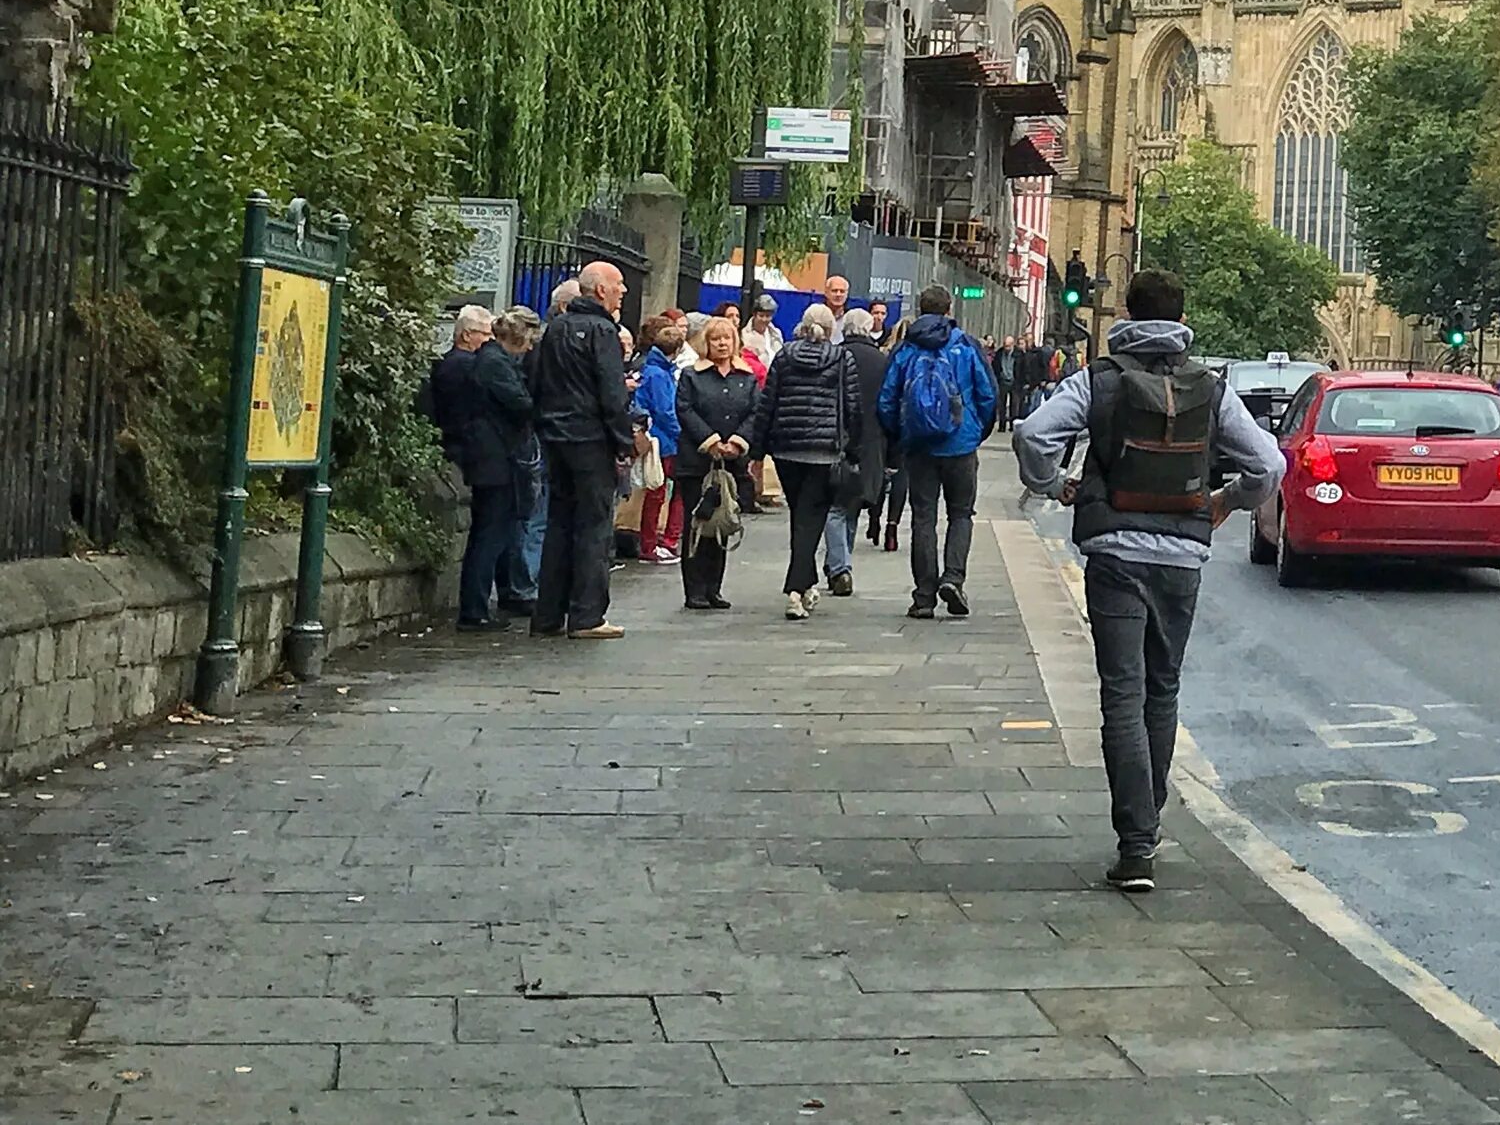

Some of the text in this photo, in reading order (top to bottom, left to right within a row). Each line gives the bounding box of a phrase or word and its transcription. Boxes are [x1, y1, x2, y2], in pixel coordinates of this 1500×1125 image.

[1386, 466, 1453, 481] YY09 HCU
[1317, 486, 1339, 500] GB
